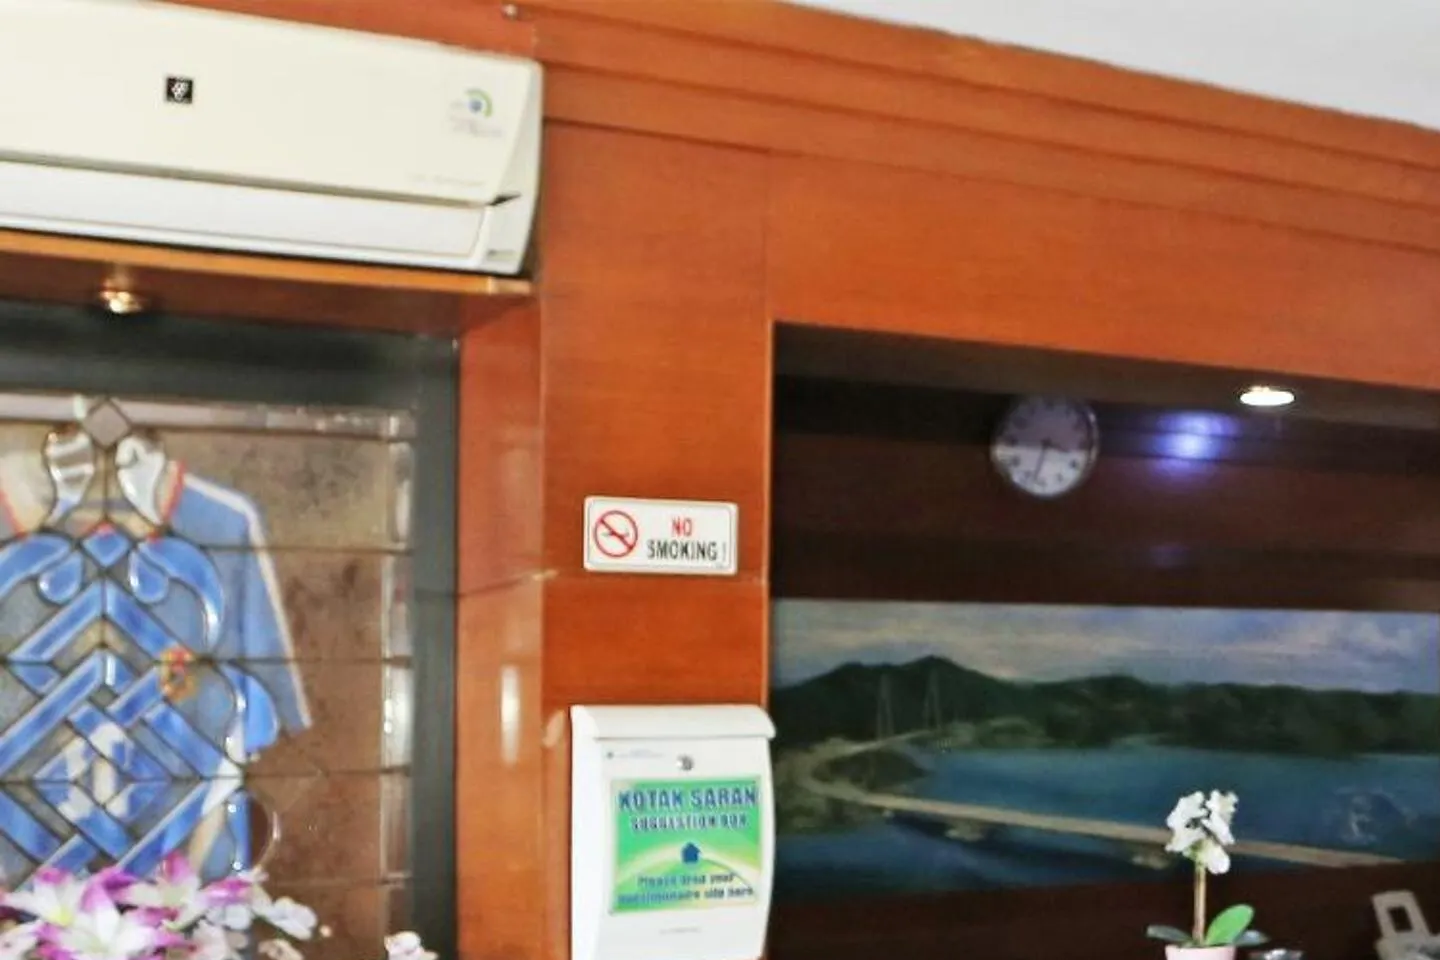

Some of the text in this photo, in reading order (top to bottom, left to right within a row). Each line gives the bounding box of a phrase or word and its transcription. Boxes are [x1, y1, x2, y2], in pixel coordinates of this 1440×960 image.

[671, 516, 693, 537] NO
[618, 786, 757, 810] KOTAK SARAN
